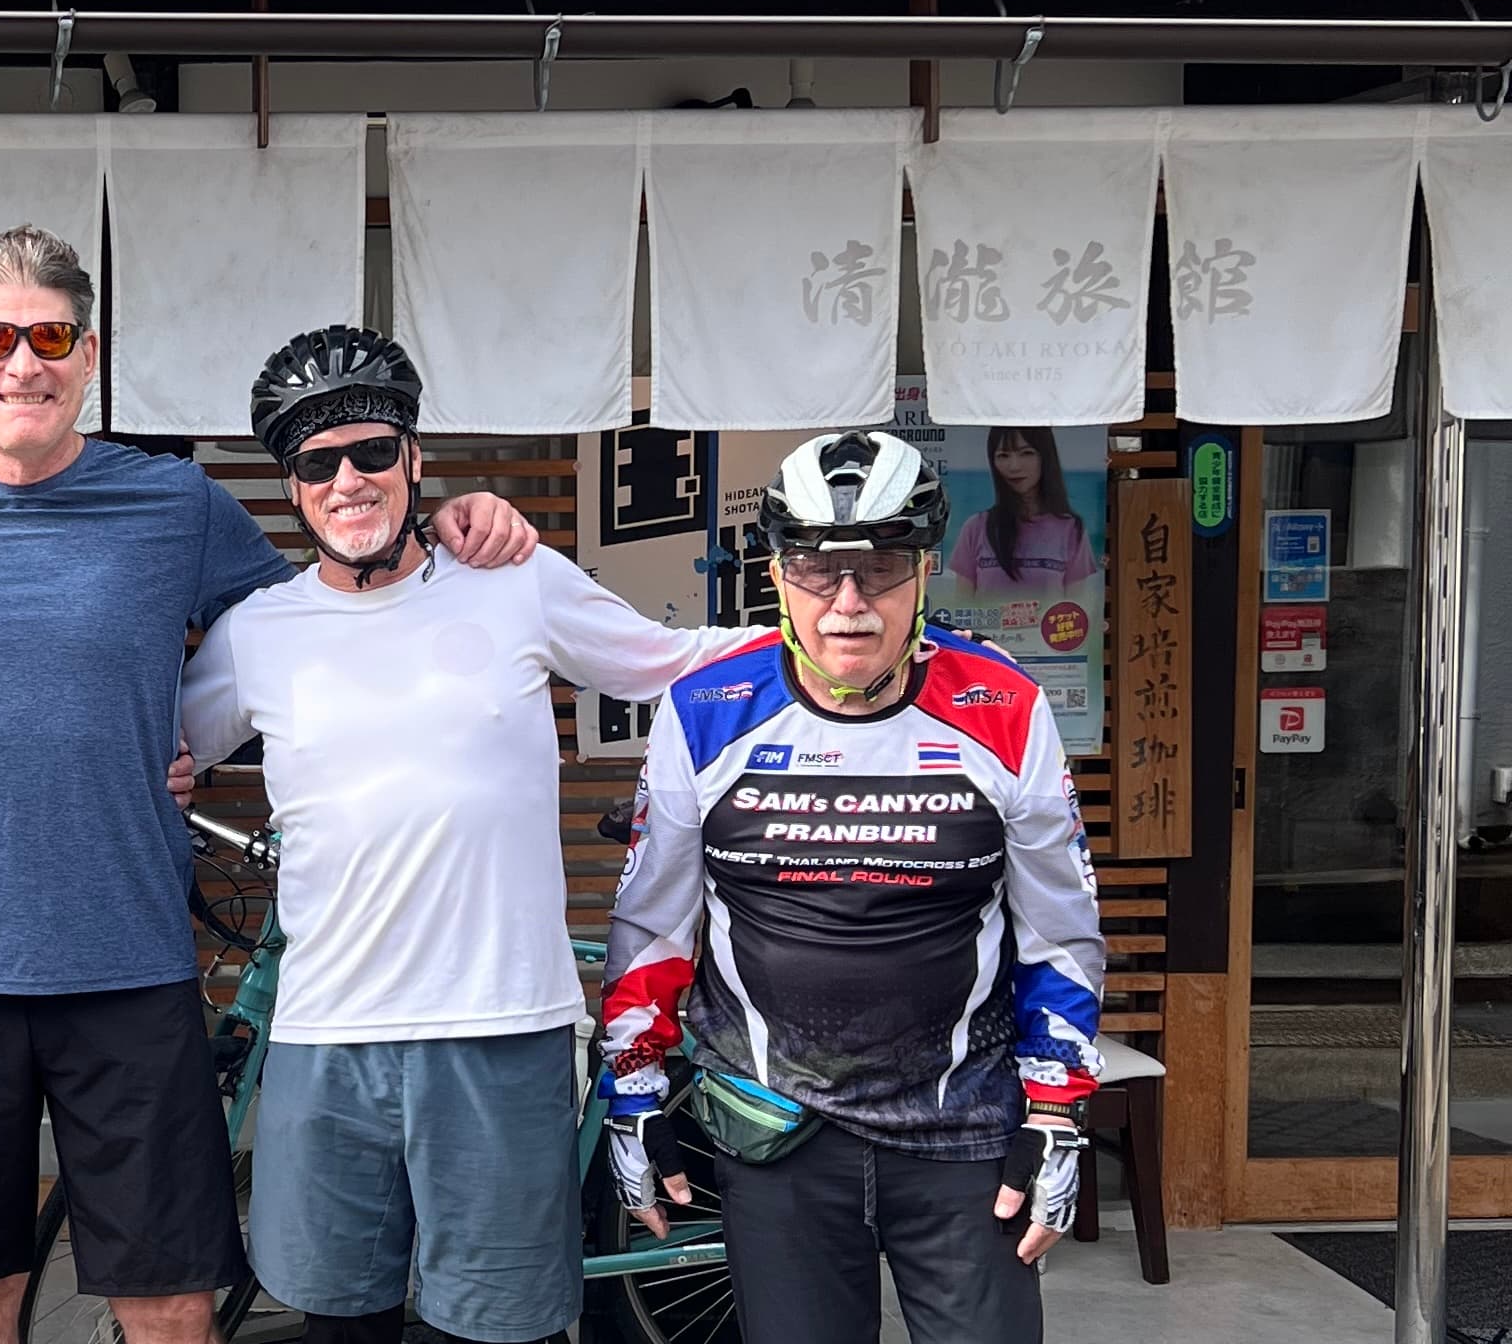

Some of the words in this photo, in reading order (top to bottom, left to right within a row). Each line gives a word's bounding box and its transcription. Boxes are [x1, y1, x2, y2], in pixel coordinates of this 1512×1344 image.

[1025, 367, 1064, 382] 1875
[1272, 733, 1312, 745] PayPay
[753, 750, 785, 765] FIM
[833, 792, 975, 813] CANYON
[763, 822, 938, 844] PRANBURI
[704, 843, 774, 865] FMSCT
[777, 870, 845, 883] FINAL
[850, 871, 934, 887] ROUND
